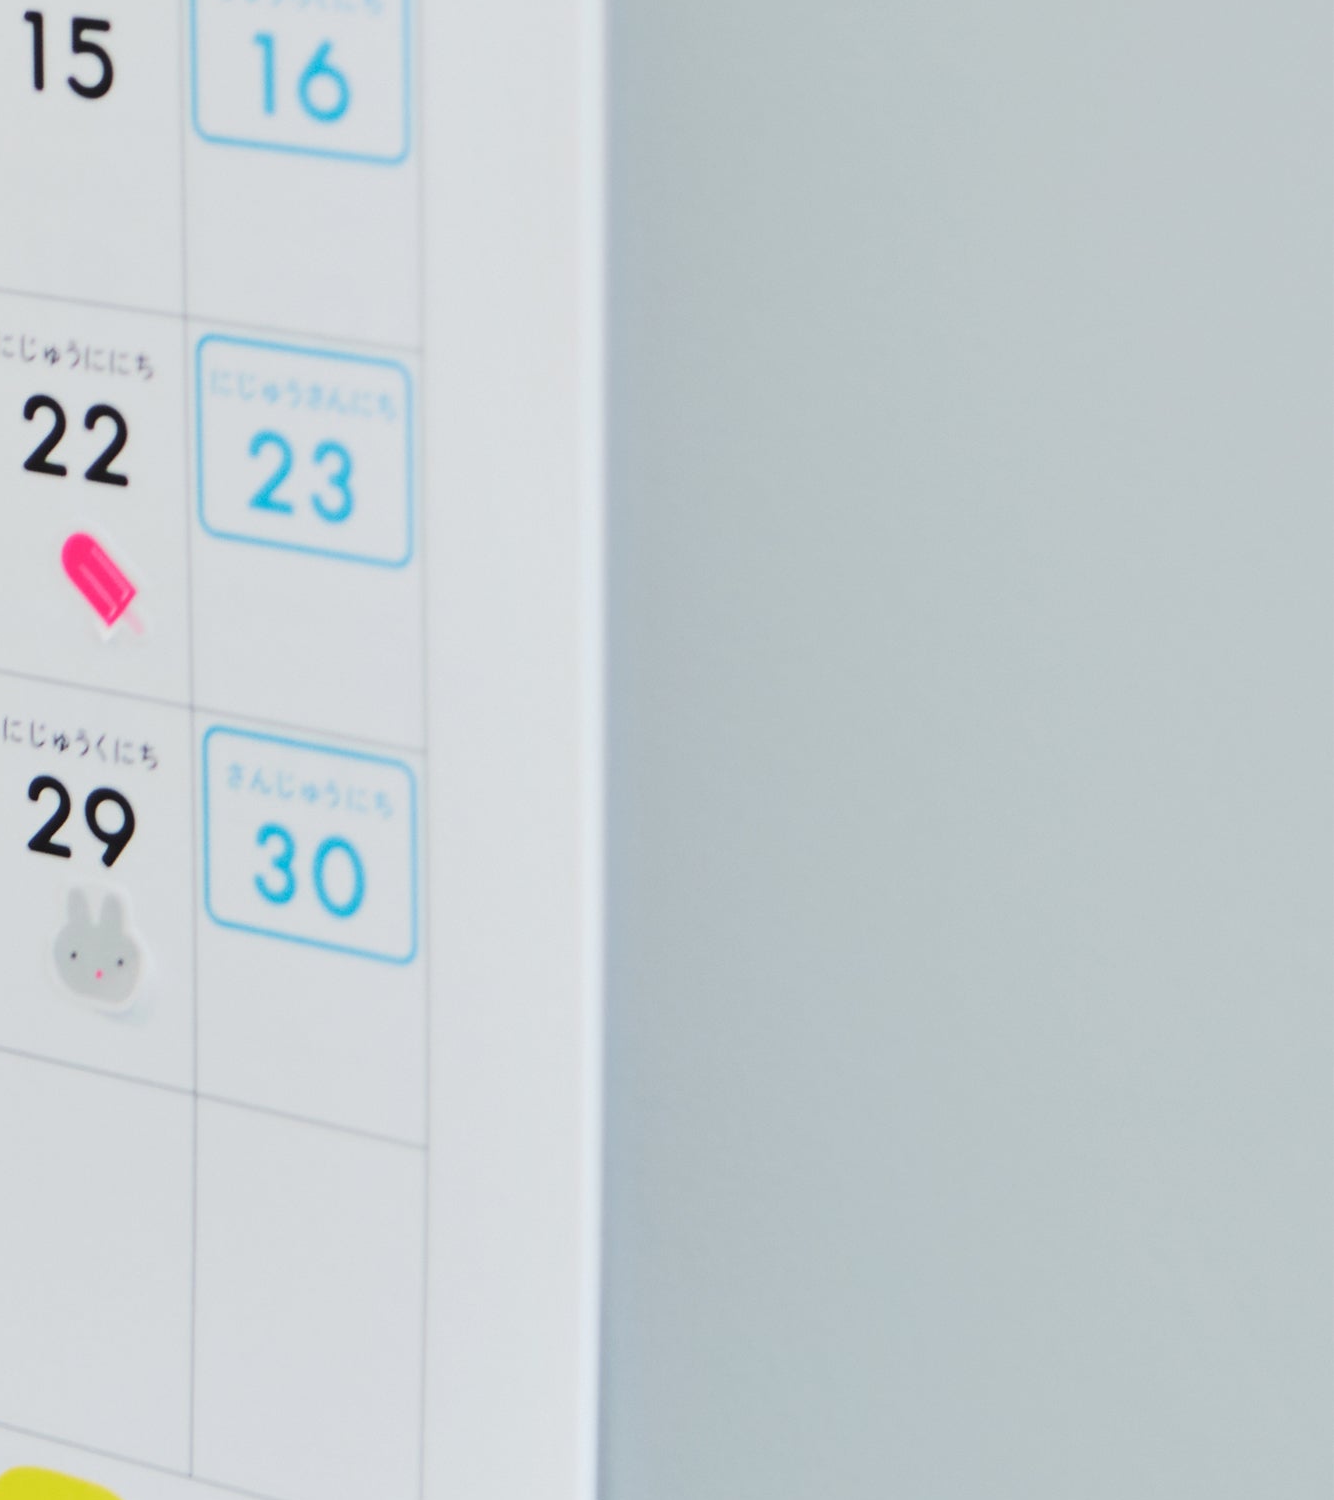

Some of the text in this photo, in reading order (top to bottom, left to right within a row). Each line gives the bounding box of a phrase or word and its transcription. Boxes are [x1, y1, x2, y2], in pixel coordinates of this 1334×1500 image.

[23, 10, 114, 100] 15
[253, 32, 352, 125] 16
[23, 393, 129, 488] 22
[248, 429, 355, 525] 23
[3, 717, 158, 771] にじゅうくにち
[27, 775, 136, 868] 29
[254, 822, 367, 920] 30
